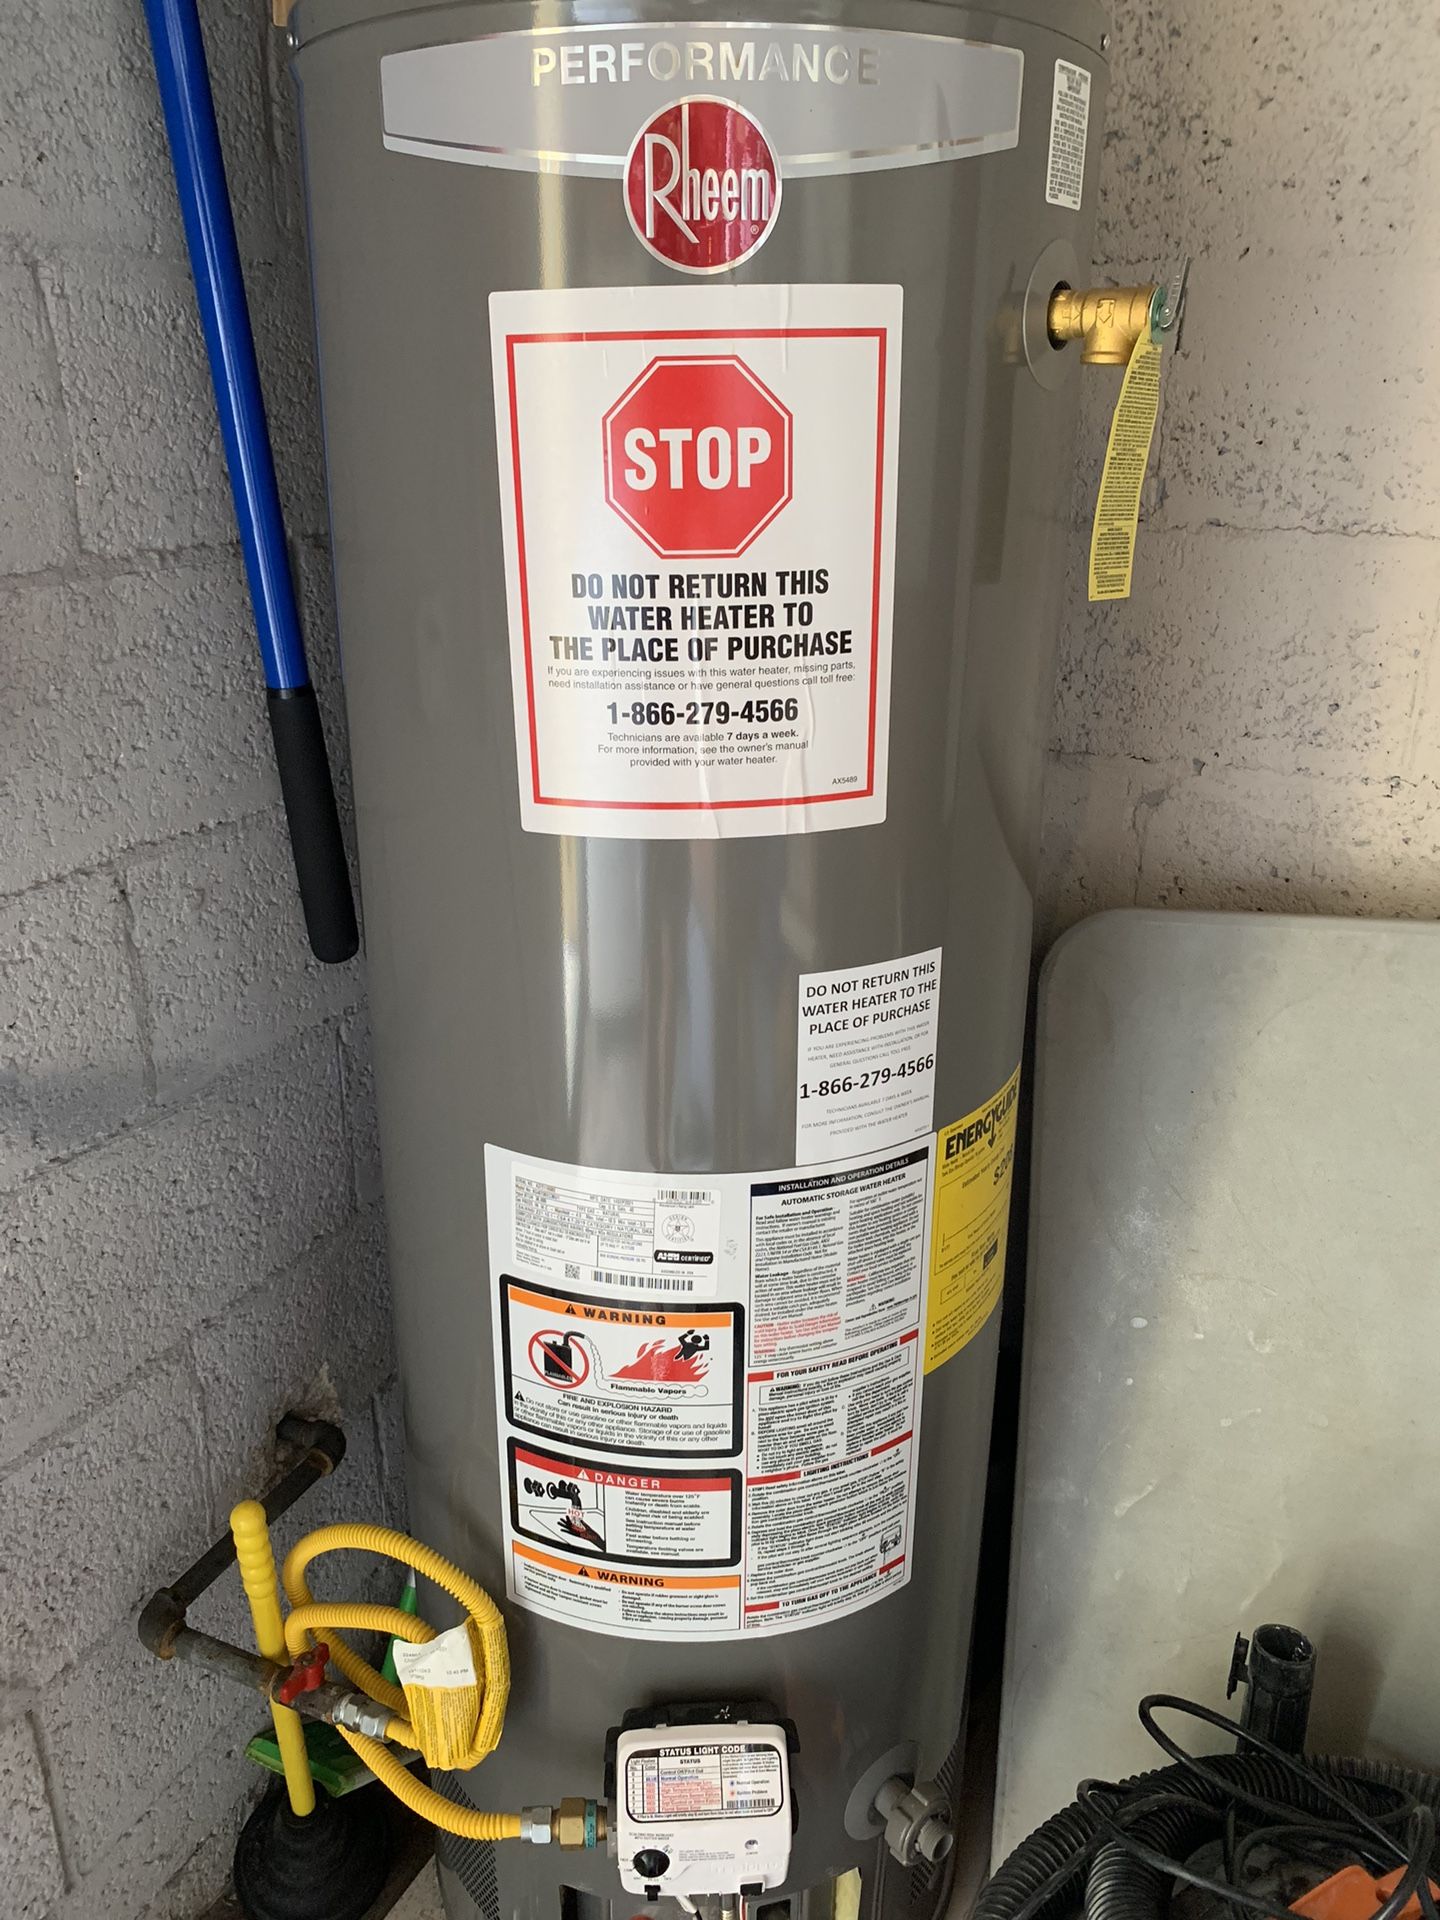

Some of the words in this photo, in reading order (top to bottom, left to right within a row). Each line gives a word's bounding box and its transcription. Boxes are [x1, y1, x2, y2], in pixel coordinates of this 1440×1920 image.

[532, 41, 880, 86] PERFORMANCE
[644, 103, 770, 243] Rheem
[623, 426, 772, 491] STOP
[571, 573, 603, 599] DO
[612, 573, 660, 599] NOT
[669, 572, 767, 599] RETURN
[776, 569, 829, 595] THIS
[588, 605, 672, 630] WATER
[681, 604, 775, 630] HEATER
[783, 601, 813, 627] TO
[549, 635, 593, 660] THE
[602, 637, 679, 662] PLACE
[688, 637, 718, 662] OF
[728, 630, 852, 660] PURCHASE
[547, 666, 553, 674] If
[555, 668, 572, 677] you
[574, 668, 590, 676] are
[591, 668, 651, 680] experiencing
[654, 668, 685, 677] issues
[688, 668, 707, 677] with
[710, 667, 727, 676] this
[729, 667, 756, 676] water
[758, 665, 791, 676] heater,
[793, 663, 829, 675] missing
[548, 679, 571, 688] need
[572, 680, 622, 690] installation
[625, 680, 675, 690] assistance
[678, 682, 688, 690] or
[691, 680, 713, 690] have
[716, 679, 752, 692] general
[754, 677, 800, 690] questions
[802, 675, 818, 685] call
[820, 674, 834, 683] toll
[606, 698, 798, 725] 1-866-279-4566
[607, 732, 662, 742] Technicians
[665, 734, 680, 742] are
[682, 733, 724, 742] available
[727, 732, 733, 741] 7
[736, 731, 760, 743] days
[771, 729, 799, 739] week.
[598, 745, 613, 753] For
[615, 746, 640, 754] more
[642, 745, 697, 755] information,
[700, 746, 717, 754] see
[720, 745, 735, 754] the
[775, 740, 809, 751] manual
[630, 758, 670, 768] provided
[672, 758, 692, 767] with
[694, 758, 716, 768] your
[717, 757, 743, 766] water
[746, 755, 778, 764] heater.
[806, 985, 827, 998] DO
[831, 980, 858, 995] NOT
[862, 969, 909, 990] RETURN
[912, 961, 936, 978] THIS
[802, 1000, 848, 1017] WATER
[852, 991, 897, 1010] HEATER
[900, 986, 915, 999] TO
[918, 979, 937, 994] THE
[810, 1019, 849, 1035] PLACE
[853, 1015, 869, 1028] OF
[872, 999, 931, 1024] PURCHASE
[800, 1053, 934, 1099] 1-866-279-4566
[779, 1179, 829, 1191] INSTALLATION
[831, 1176, 846, 1184] AND
[848, 1166, 884, 1179] OPERATION
[886, 1157, 909, 1170] DETAILS
[782, 1194, 825, 1206] AUTOMATIC
[827, 1187, 858, 1199] STORAGE
[860, 1181, 882, 1191] WATER
[883, 1173, 906, 1186] HEATER
[583, 1307, 666, 1325] WARNING
[809, 1364, 831, 1373] SAFETY
[832, 1360, 847, 1368] READ
[848, 1352, 869, 1363] BEFORE
[870, 1341, 897, 1357] OPERATING
[610, 1383, 655, 1394] Flammable
[558, 1399, 570, 1407] Can
[597, 1401, 639, 1411] EXPLOSION
[595, 1473, 660, 1489] DANGER
[568, 1509, 585, 1517] HOT
[597, 1571, 665, 1587] WARNING
[850, 1573, 877, 1588] APPLIANCE
[660, 1748, 691, 1756] STATUS
[694, 1747, 719, 1755] LIGHT
[722, 1745, 745, 1753] CODE
